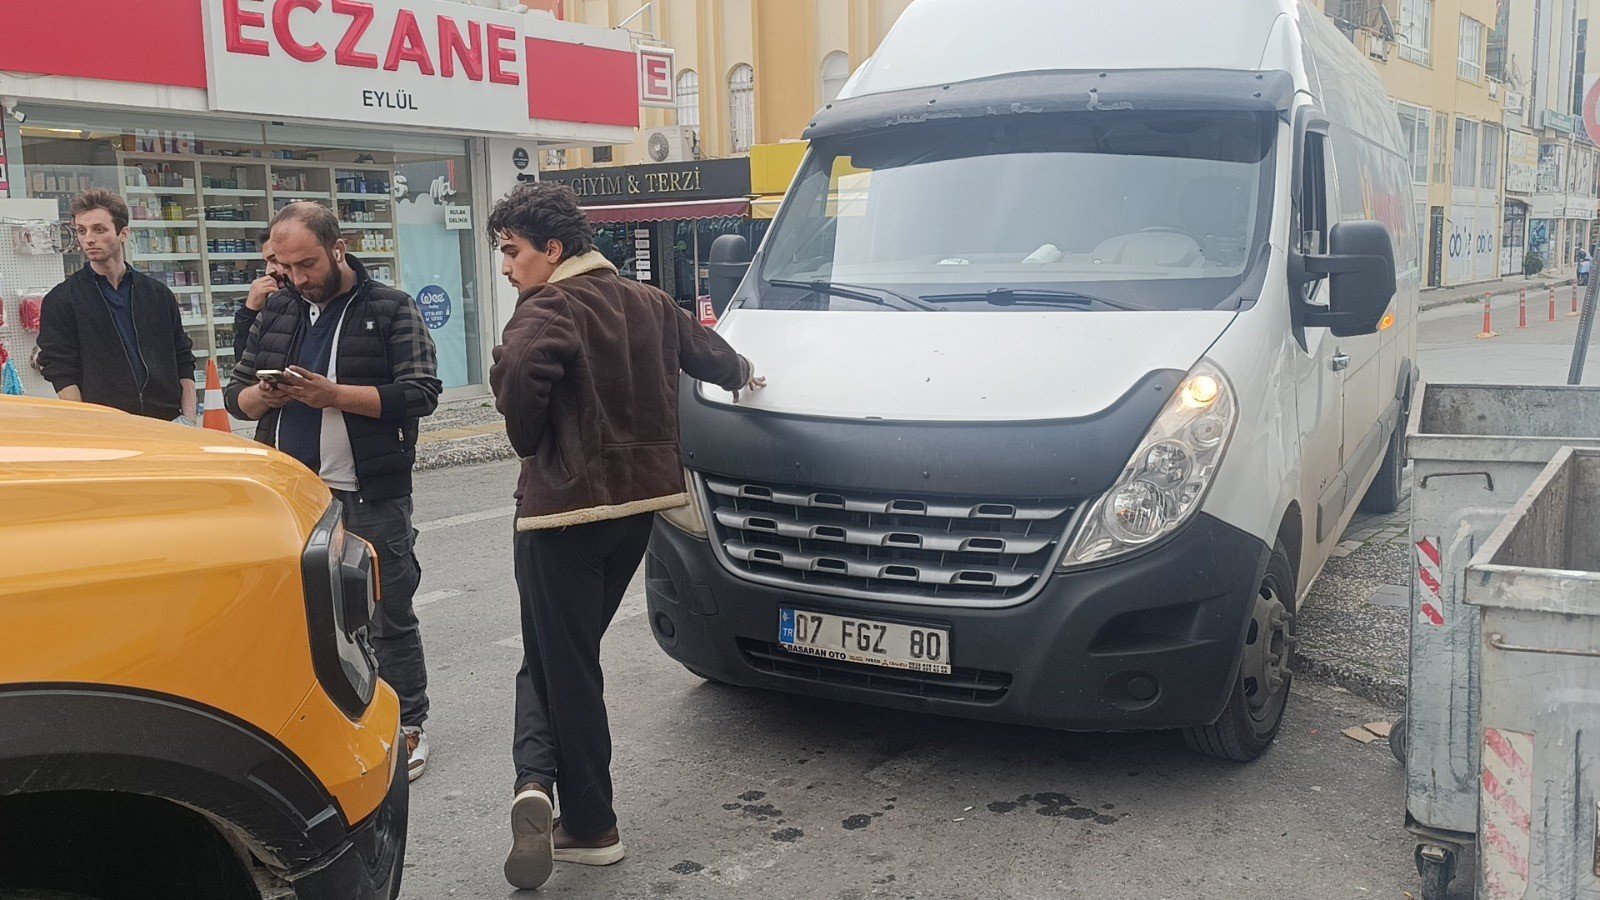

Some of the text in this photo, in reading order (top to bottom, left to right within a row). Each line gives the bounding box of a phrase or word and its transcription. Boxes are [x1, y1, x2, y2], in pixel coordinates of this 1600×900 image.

[225, 0, 520, 86] ECZANE
[362, 89, 418, 110] EYLÜL
[571, 166, 701, 196] GİYİM & TERZİ
[783, 627, 794, 637] TR
[796, 613, 941, 661] 07 FGZ 80
[828, 650, 847, 660] OTO
